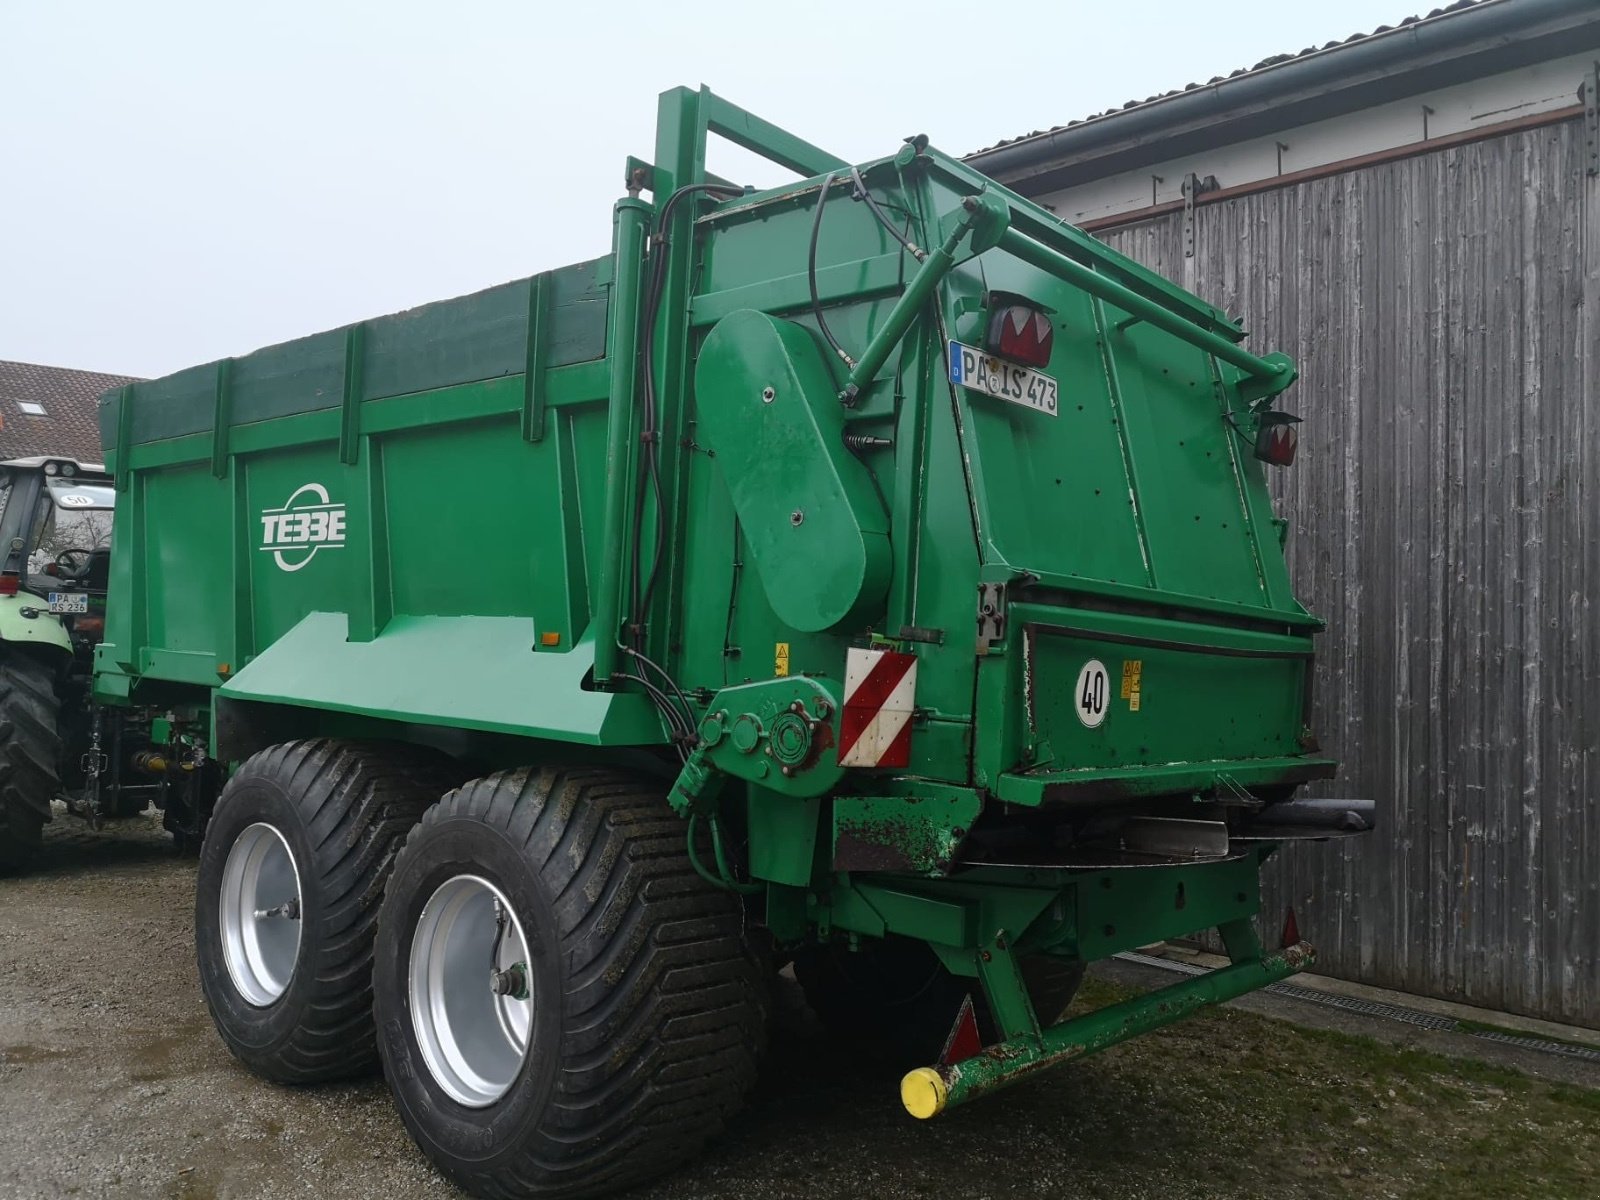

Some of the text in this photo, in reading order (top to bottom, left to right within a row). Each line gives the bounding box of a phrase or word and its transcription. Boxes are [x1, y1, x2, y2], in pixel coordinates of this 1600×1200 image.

[962, 351, 1056, 411] PA IS 473
[66, 496, 88, 505] 50
[57, 594, 69, 603] PA
[67, 603, 85, 612] 236
[1081, 670, 1104, 715] 40
